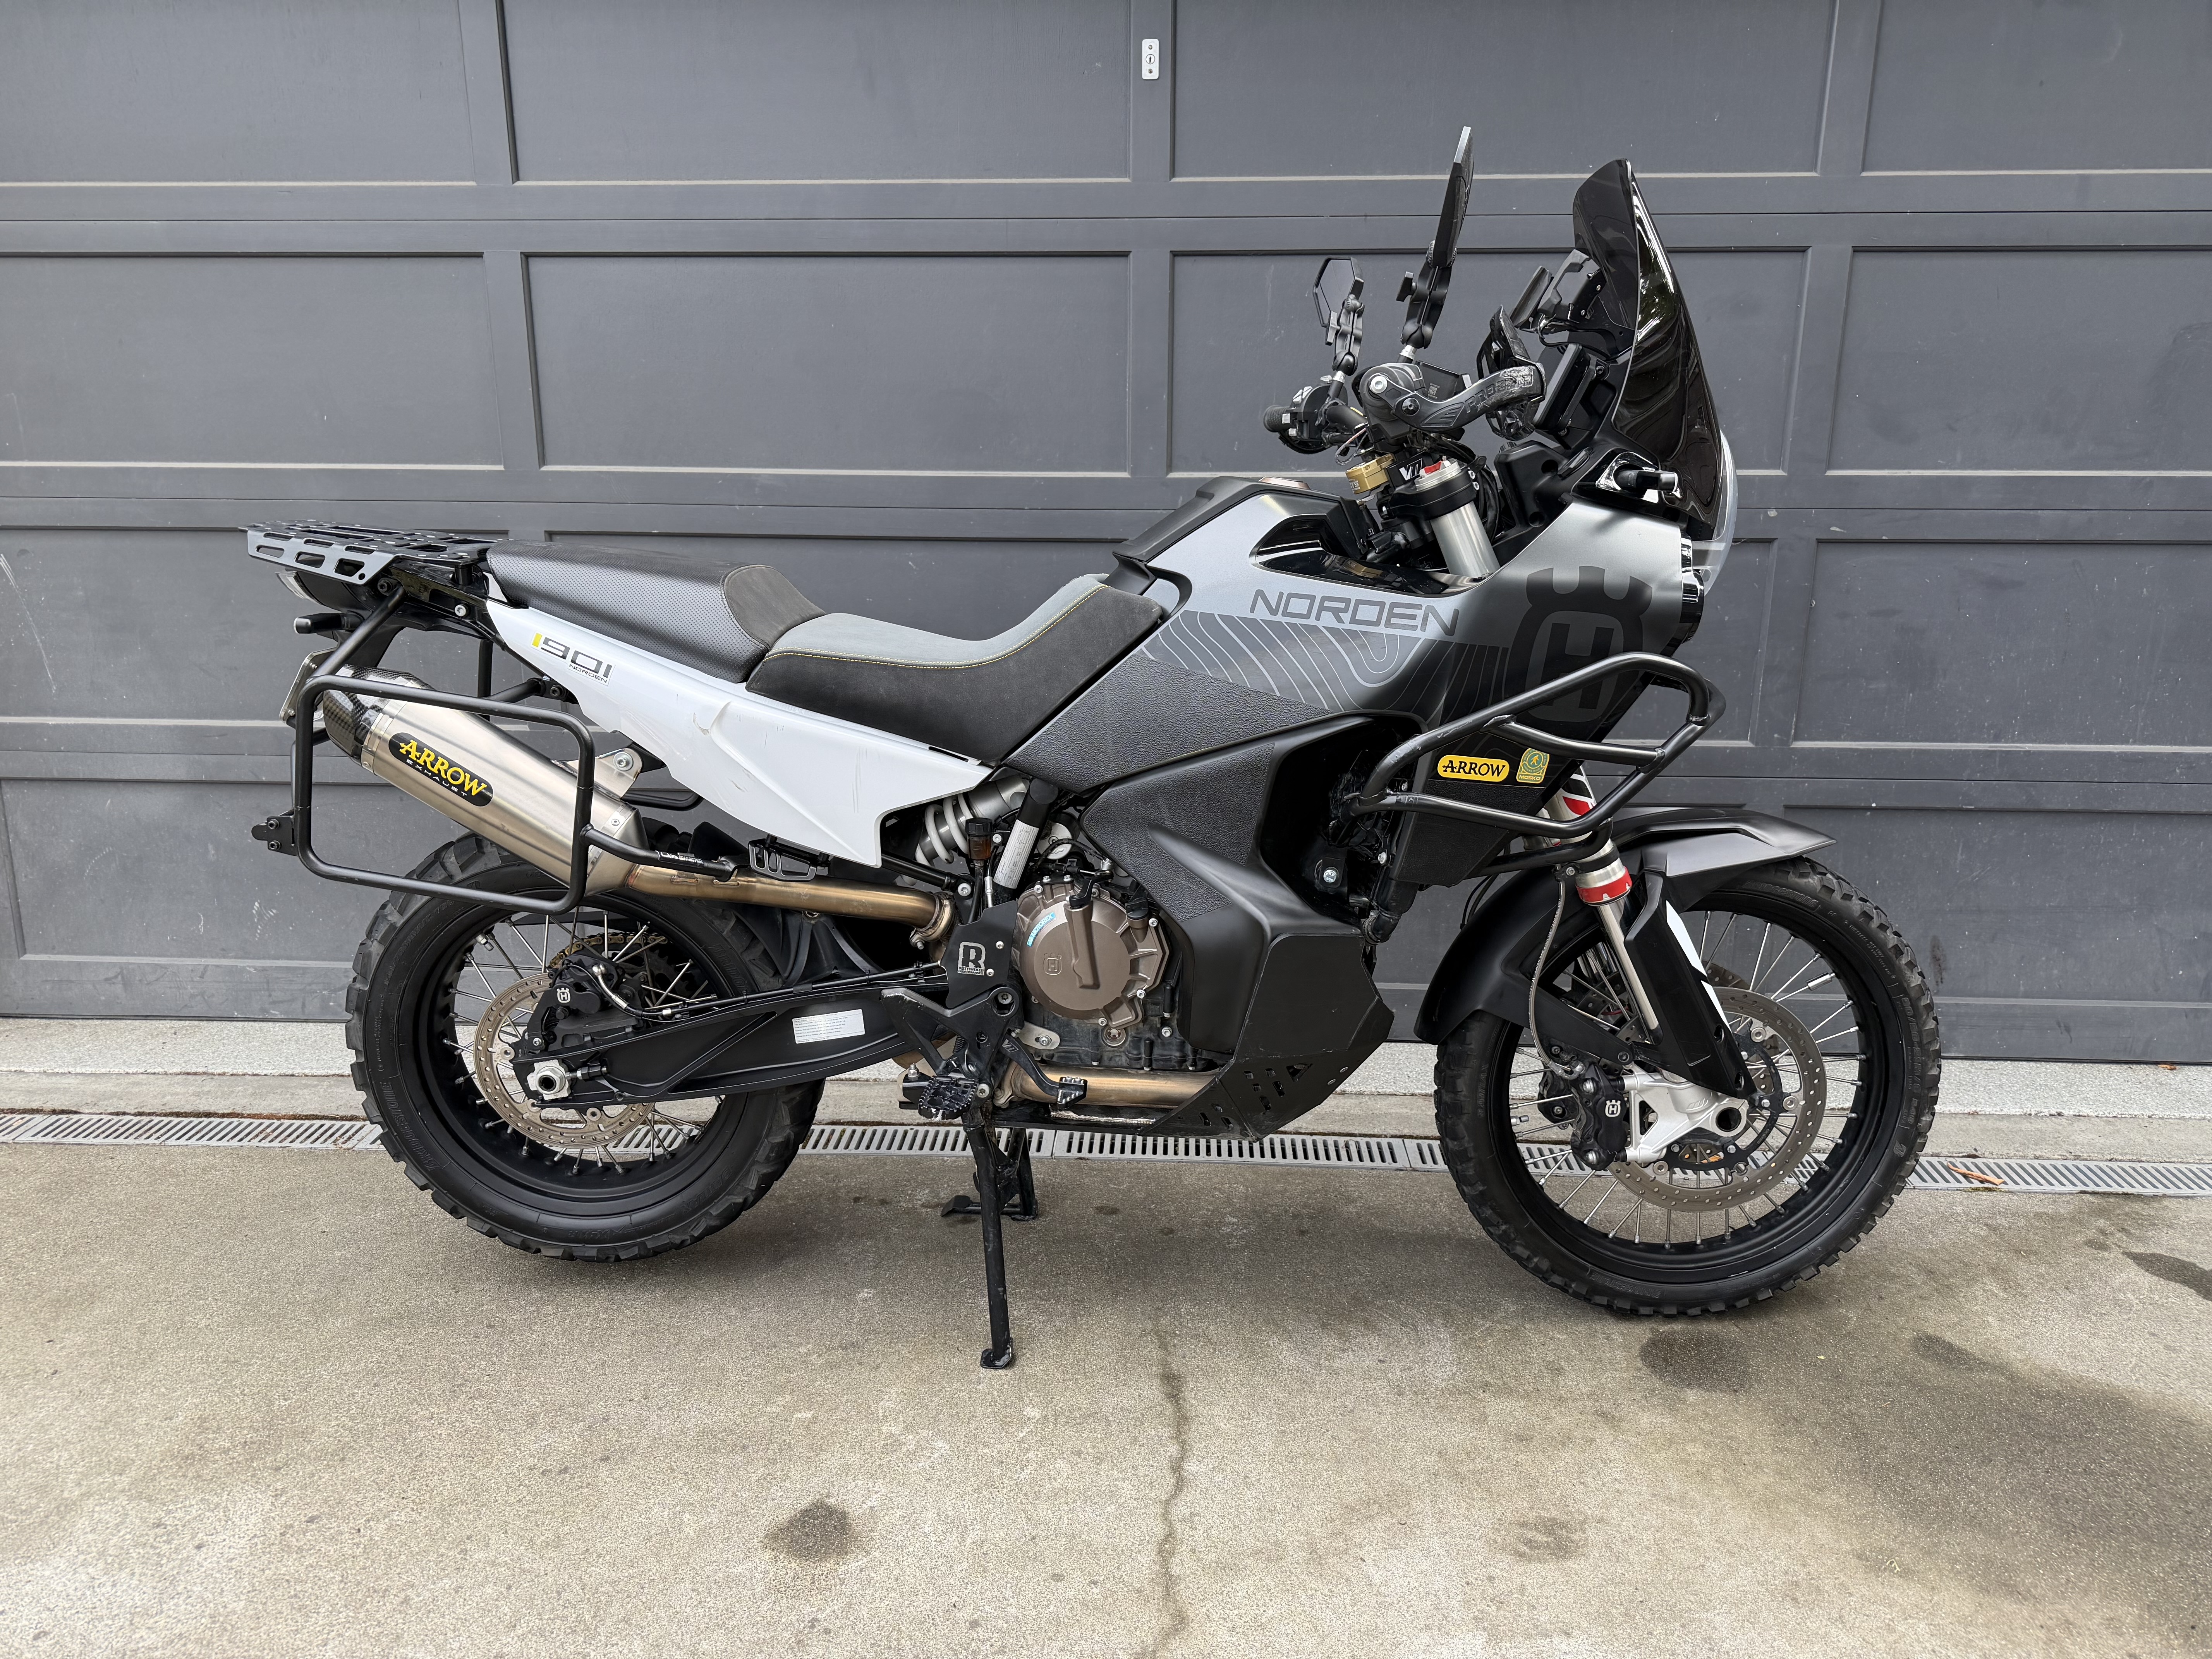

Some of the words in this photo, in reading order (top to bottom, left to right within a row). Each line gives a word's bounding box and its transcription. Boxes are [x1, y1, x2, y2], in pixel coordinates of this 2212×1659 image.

[1250, 589, 1459, 636] NORDEN
[569, 664, 607, 683] NORDEN
[400, 739, 487, 796] ARROW
[407, 759, 467, 796] EXHAUST
[1442, 760, 1506, 777] ARROW
